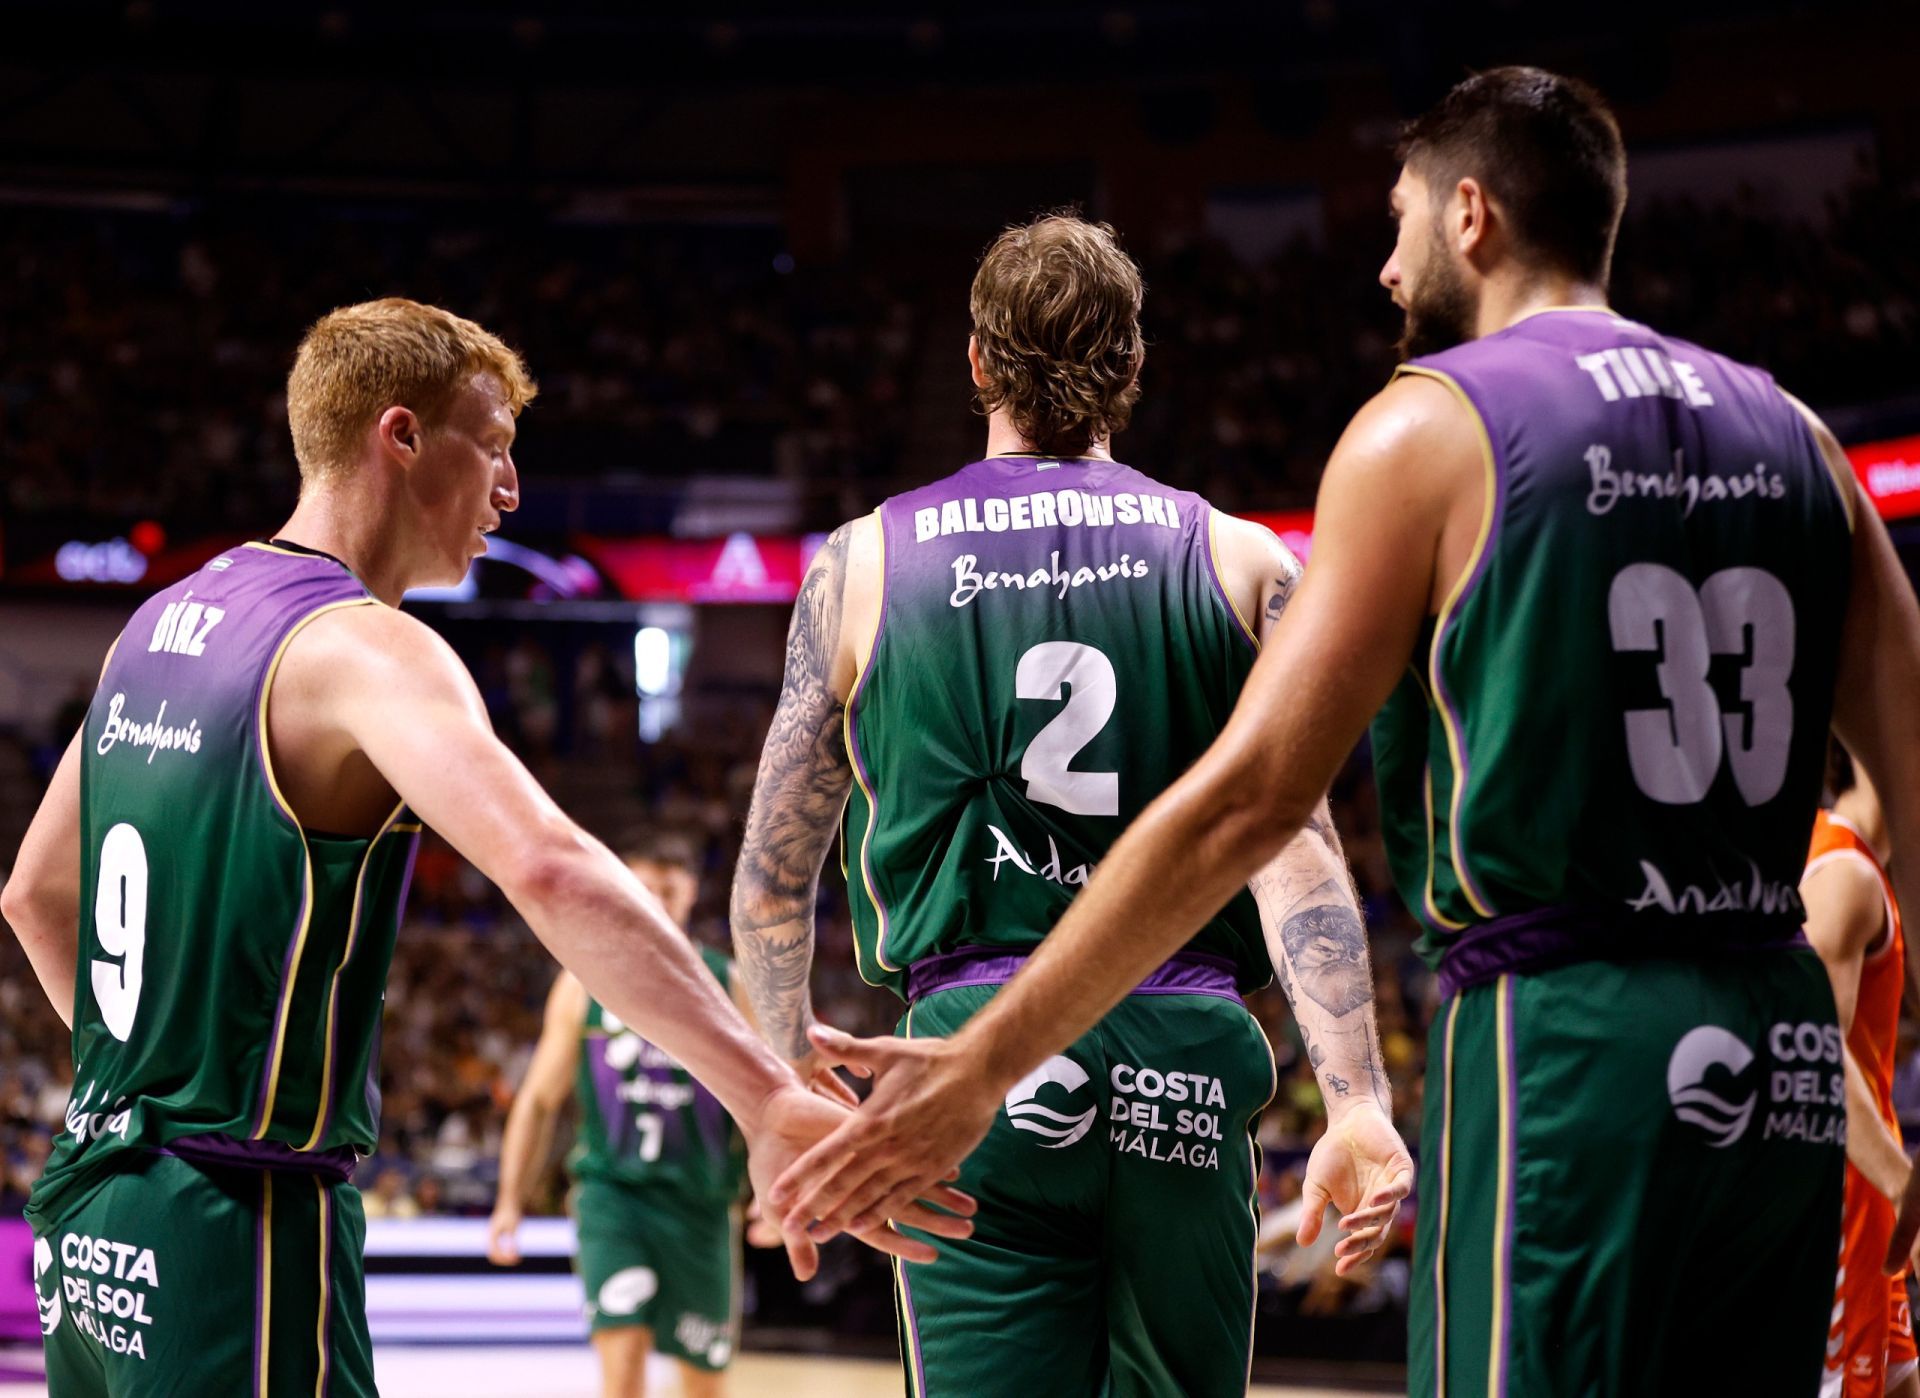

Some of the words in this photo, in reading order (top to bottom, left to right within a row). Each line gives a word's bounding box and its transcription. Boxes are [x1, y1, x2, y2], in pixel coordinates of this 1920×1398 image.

[915, 490, 1181, 543] BALCEROWSKI
[148, 590, 226, 657] DÍAZ
[1608, 562, 1796, 807] 33
[1016, 641, 1118, 816] 2
[91, 823, 148, 1042] 9
[1769, 1022, 1843, 1063] COS
[1110, 1063, 1227, 1109] COSTA
[1771, 1071, 1826, 1104] DEL
[1110, 1096, 1169, 1131] DEL
[1175, 1109, 1223, 1141] SOL
[1110, 1126, 1219, 1171] MÁLAGA
[61, 1232, 159, 1288] COSTA
[62, 1275, 95, 1309] DEL
[96, 1283, 152, 1325] SOL
